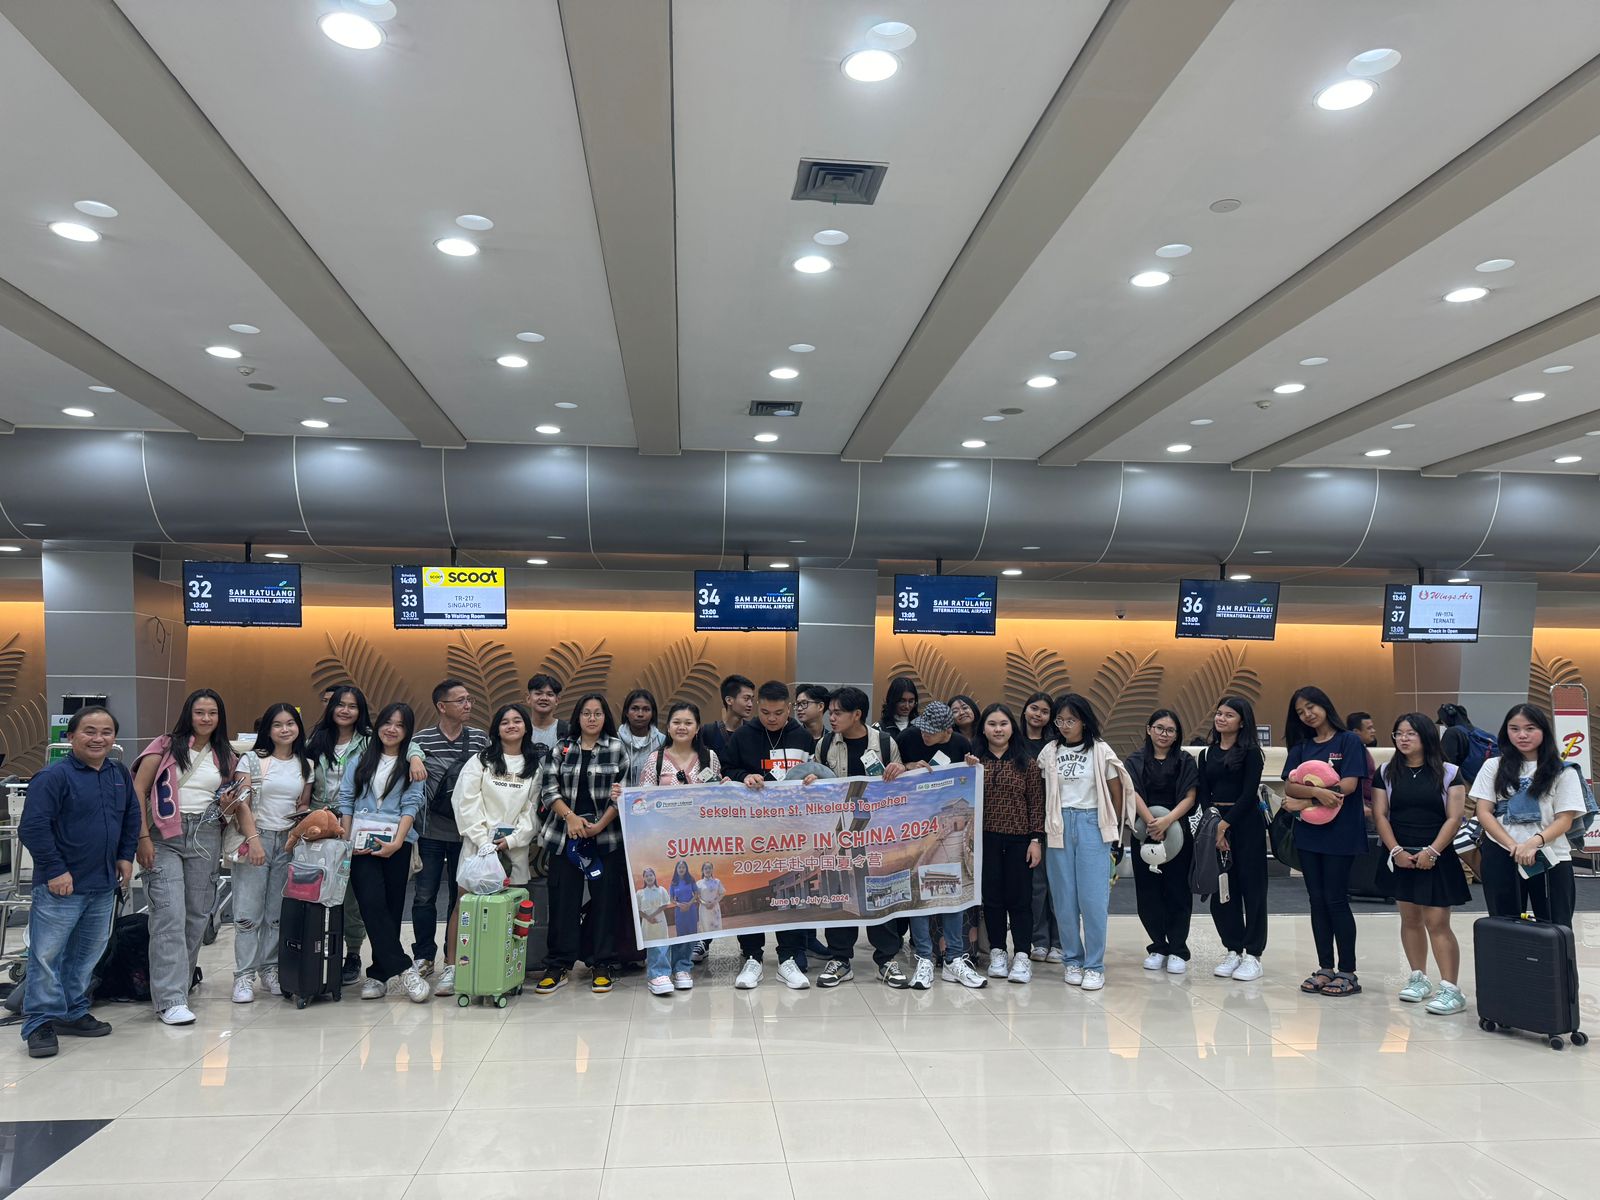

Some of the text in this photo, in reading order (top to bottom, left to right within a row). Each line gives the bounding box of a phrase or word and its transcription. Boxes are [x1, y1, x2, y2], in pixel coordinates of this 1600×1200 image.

[448, 570, 497, 583] scoot
[189, 580, 212, 598] 32
[698, 588, 720, 605] 34
[1430, 592, 1456, 601] Wings
[401, 594, 417, 606] 33
[898, 592, 919, 608] 35
[1182, 597, 1203, 613] 36
[1391, 611, 1405, 622] 37
[700, 795, 907, 817] Sekolah Lokon St. Nikolaus Tomohon
[667, 817, 939, 858] SUMMER CAMP IN CHINA 2024
[733, 852, 882, 874] 2024年赴中国夏令营
[806, 896, 821, 905] July
[831, 894, 849, 902] 2024
